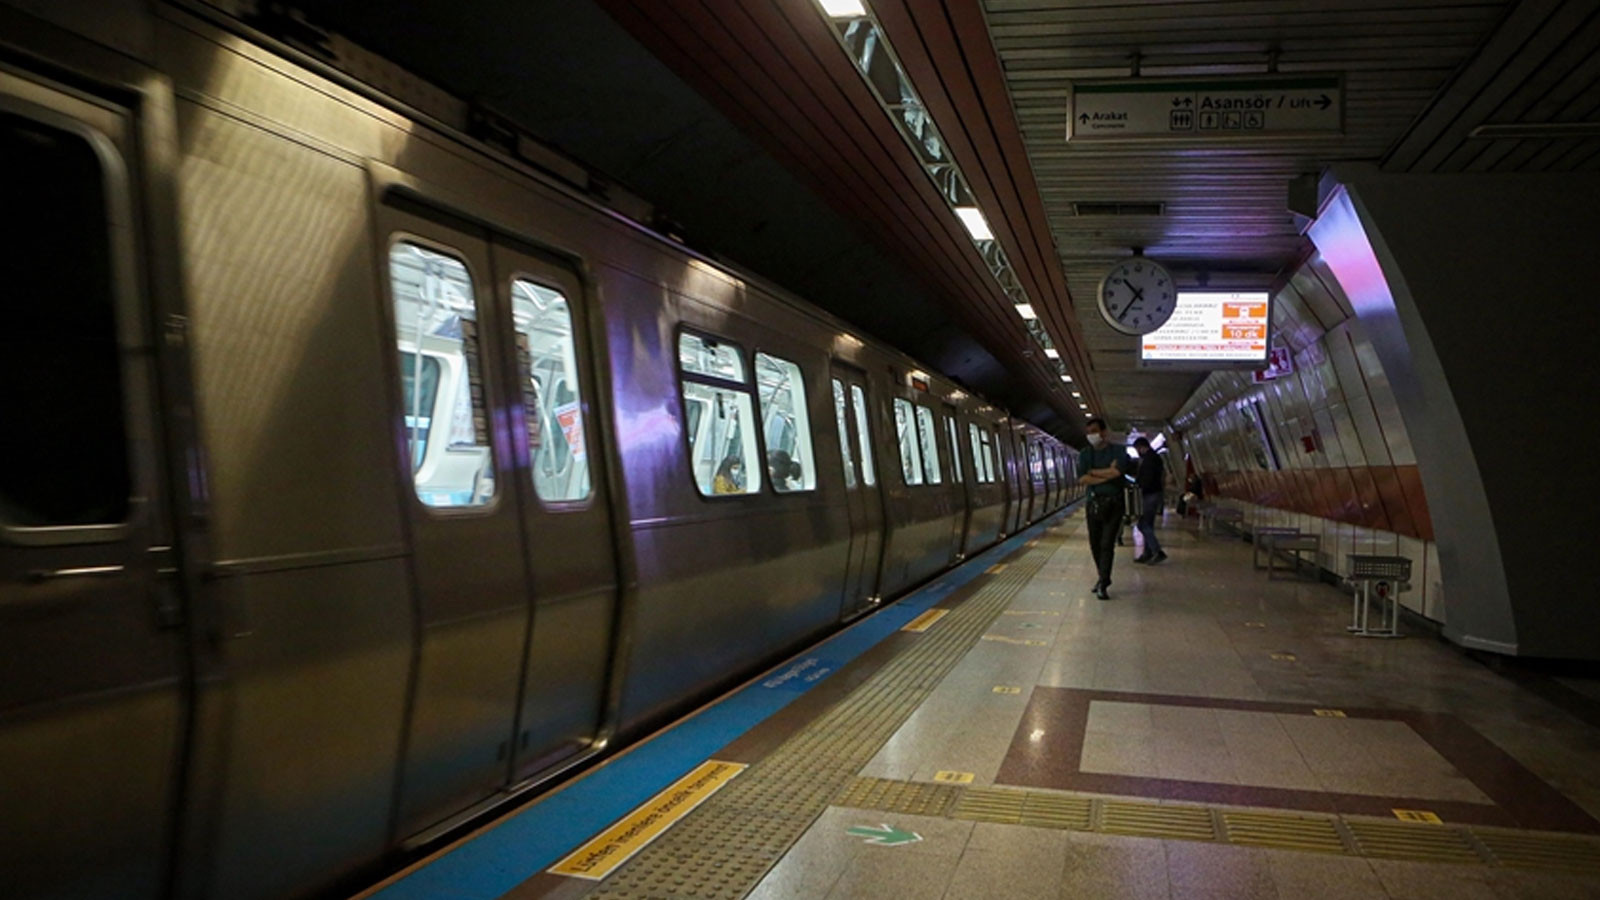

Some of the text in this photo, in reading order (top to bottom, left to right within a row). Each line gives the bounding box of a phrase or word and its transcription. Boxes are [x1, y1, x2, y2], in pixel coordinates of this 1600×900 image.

[1201, 94, 1272, 109] Asansör
[1290, 97, 1311, 109] Lift
[1092, 111, 1128, 121] Arakat
[1230, 328, 1258, 338] 10 dk
[570, 843, 620, 872] Lütfen
[609, 814, 662, 844] inenlere
[654, 789, 693, 813] öncelik
